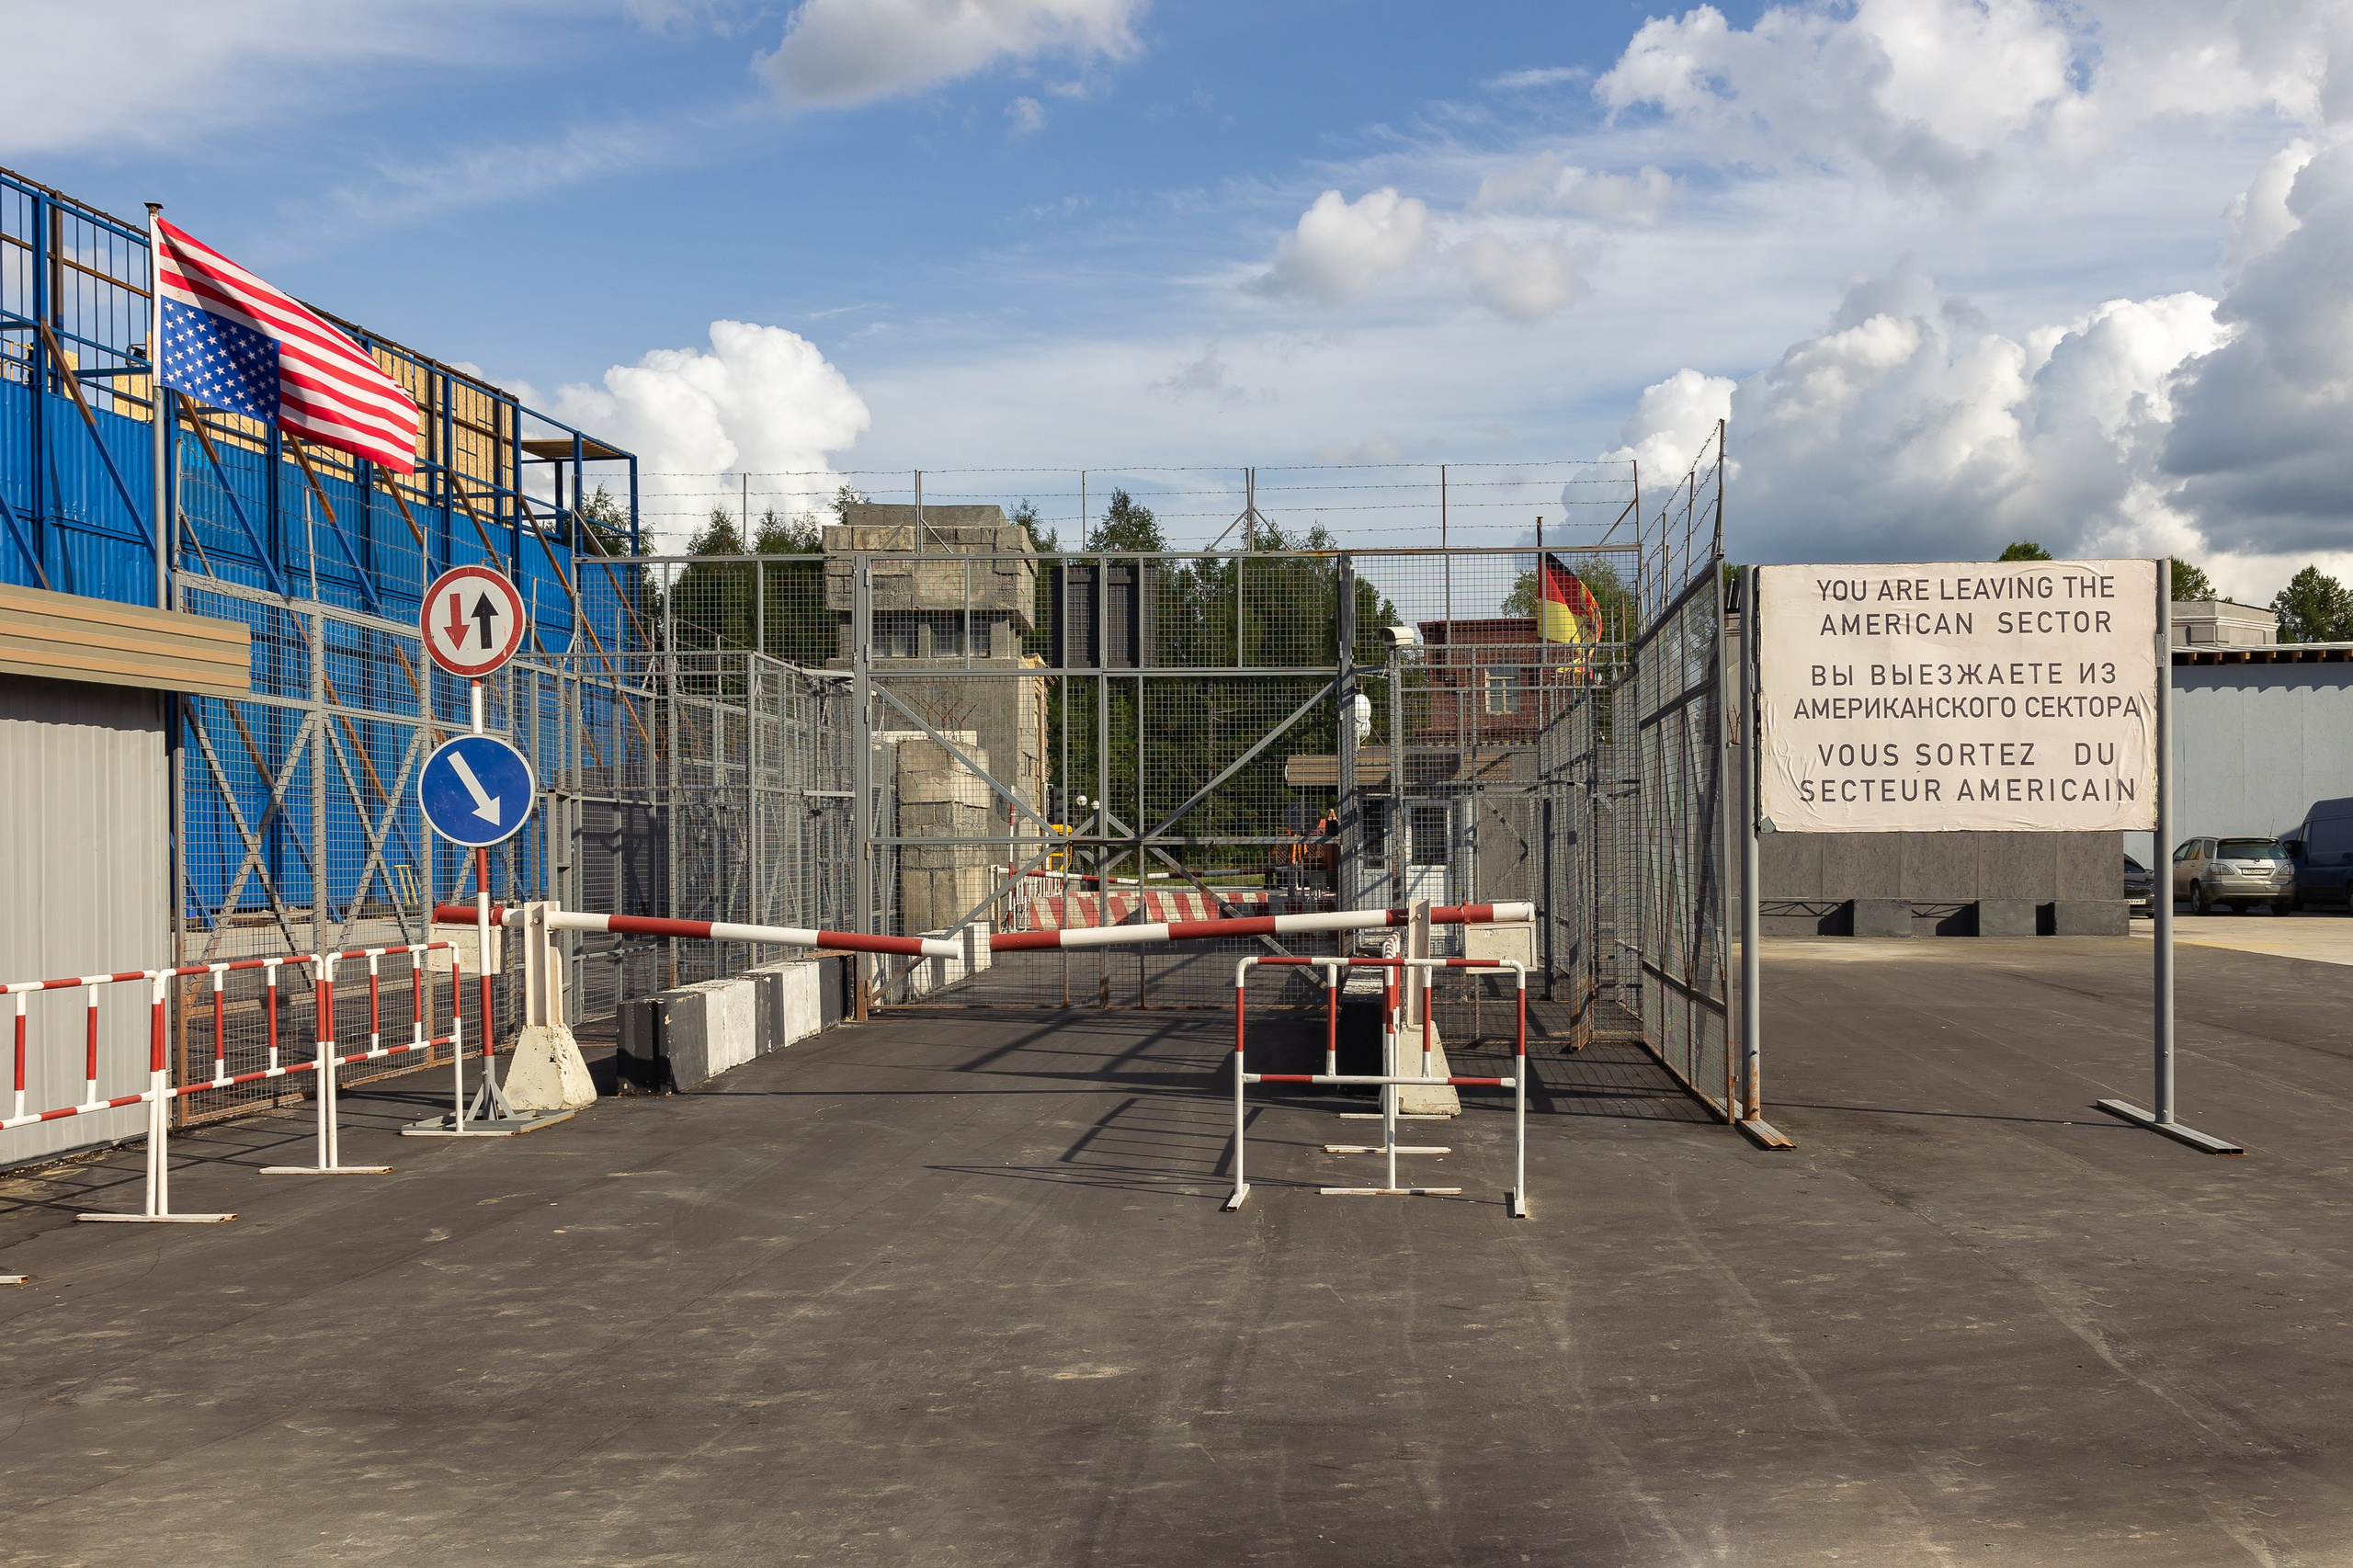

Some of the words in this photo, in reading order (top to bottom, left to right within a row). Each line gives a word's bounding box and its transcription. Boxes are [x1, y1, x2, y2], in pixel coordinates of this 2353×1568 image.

[1817, 579, 1867, 602] YOU
[1877, 579, 1929, 601] ARE
[1940, 576, 2053, 600] LEAVING
[2063, 575, 2115, 598] THE
[1820, 612, 1972, 636] AMERICAN
[1997, 610, 2111, 634] SECTOR
[1812, 665, 1853, 687] ВЫ
[1870, 663, 2063, 686] ВЫЕЗЖАЕТЕ
[2079, 662, 2116, 684] ИЗ
[1793, 696, 2016, 720] АМЕРИКАНСКОГО
[2025, 696, 2141, 718] СЕКТОРА
[1817, 743, 1899, 767] VOUS
[1915, 743, 2035, 767] SORTEZ
[2075, 742, 2114, 766] DU
[1800, 778, 1941, 802] SECTEUR
[1956, 778, 2135, 801] AMERICAIN
